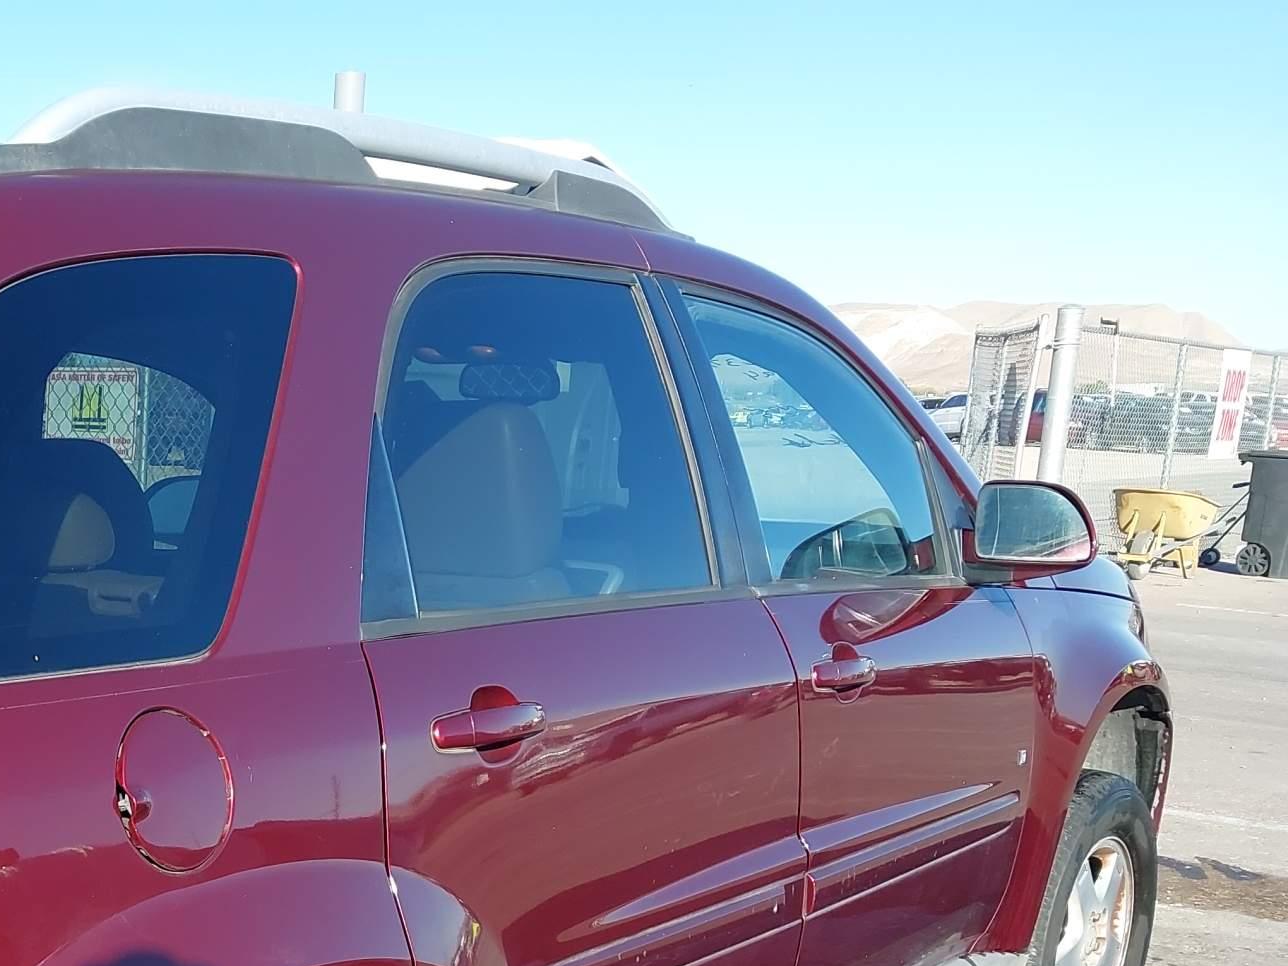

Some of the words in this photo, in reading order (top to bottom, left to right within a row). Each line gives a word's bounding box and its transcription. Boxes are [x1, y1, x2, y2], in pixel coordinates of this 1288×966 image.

[97, 373, 107, 381] OF
[108, 373, 135, 382] SAFETY
[1222, 369, 1246, 403] DROP
